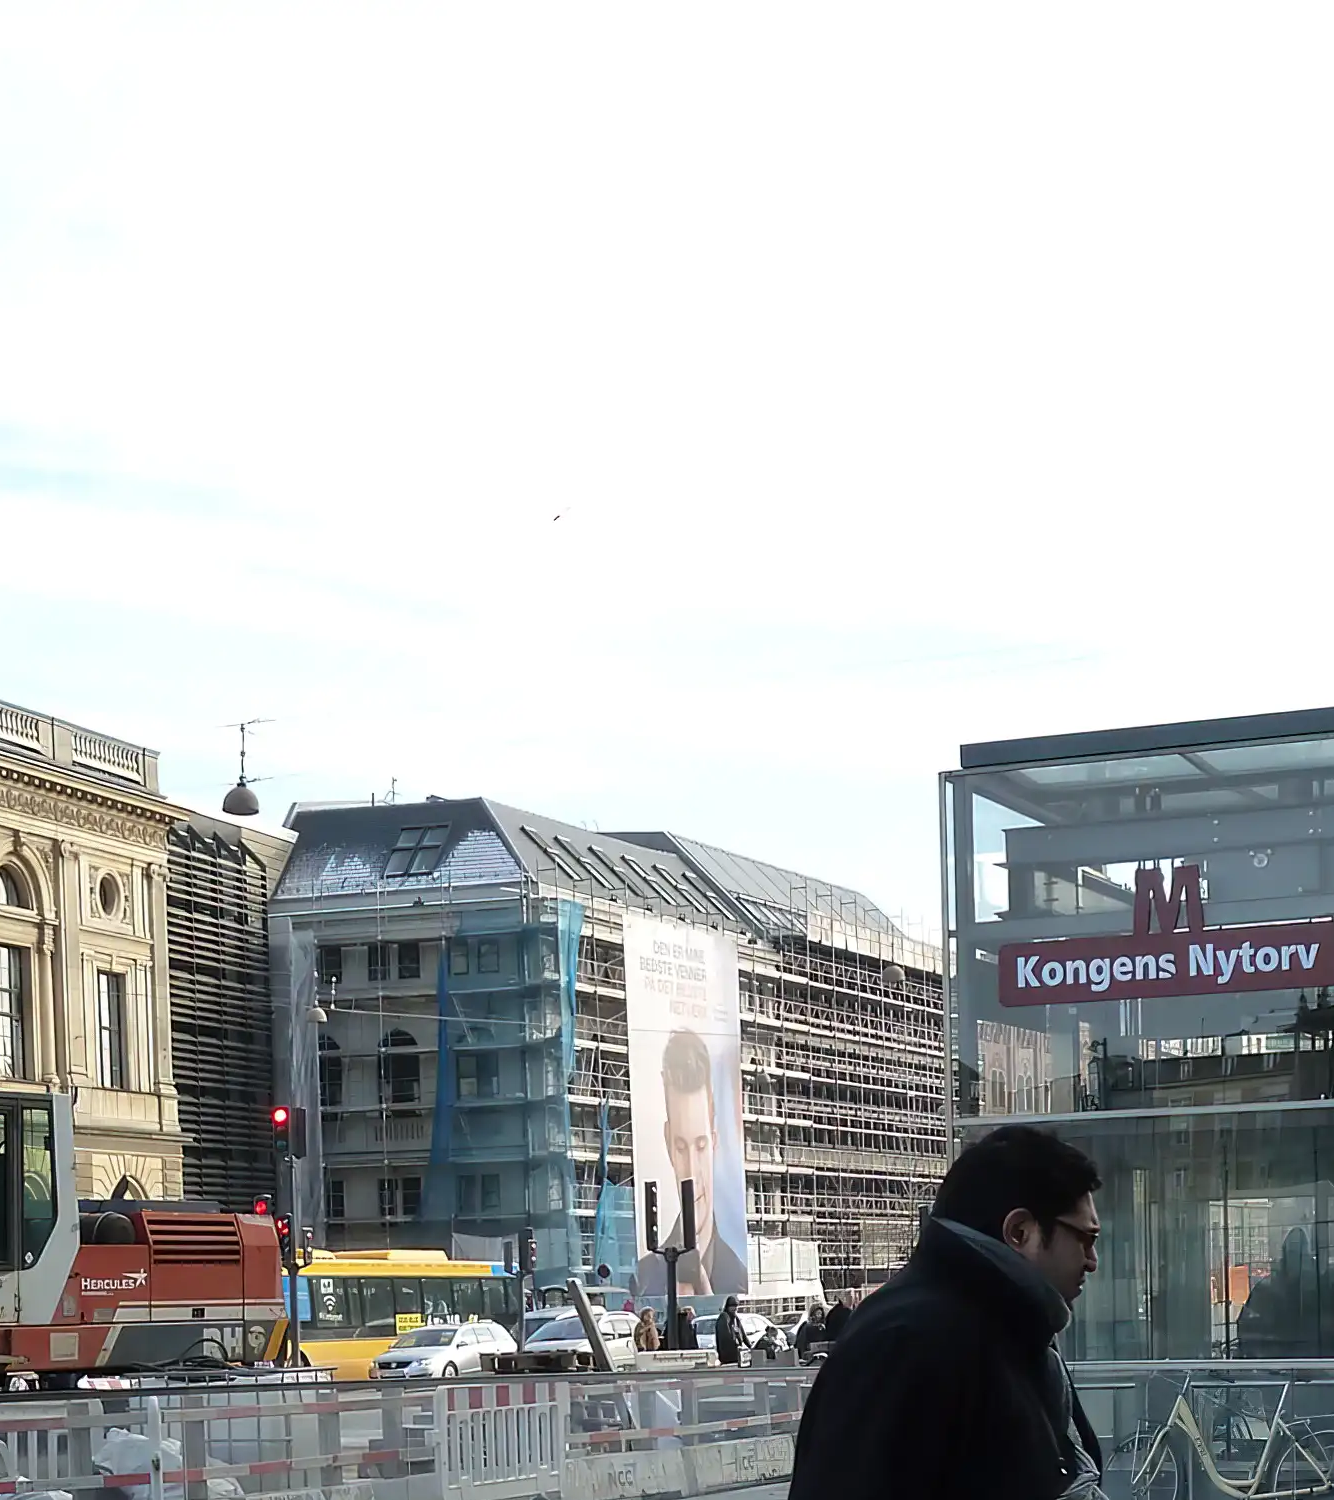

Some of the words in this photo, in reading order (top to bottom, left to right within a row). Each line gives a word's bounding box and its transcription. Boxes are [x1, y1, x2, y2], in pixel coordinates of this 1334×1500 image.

[1134, 864, 1205, 936] M
[1017, 951, 1176, 992] Kongens
[1188, 940, 1320, 984] Nytorv
[81, 1277, 135, 1290] HERCULES
